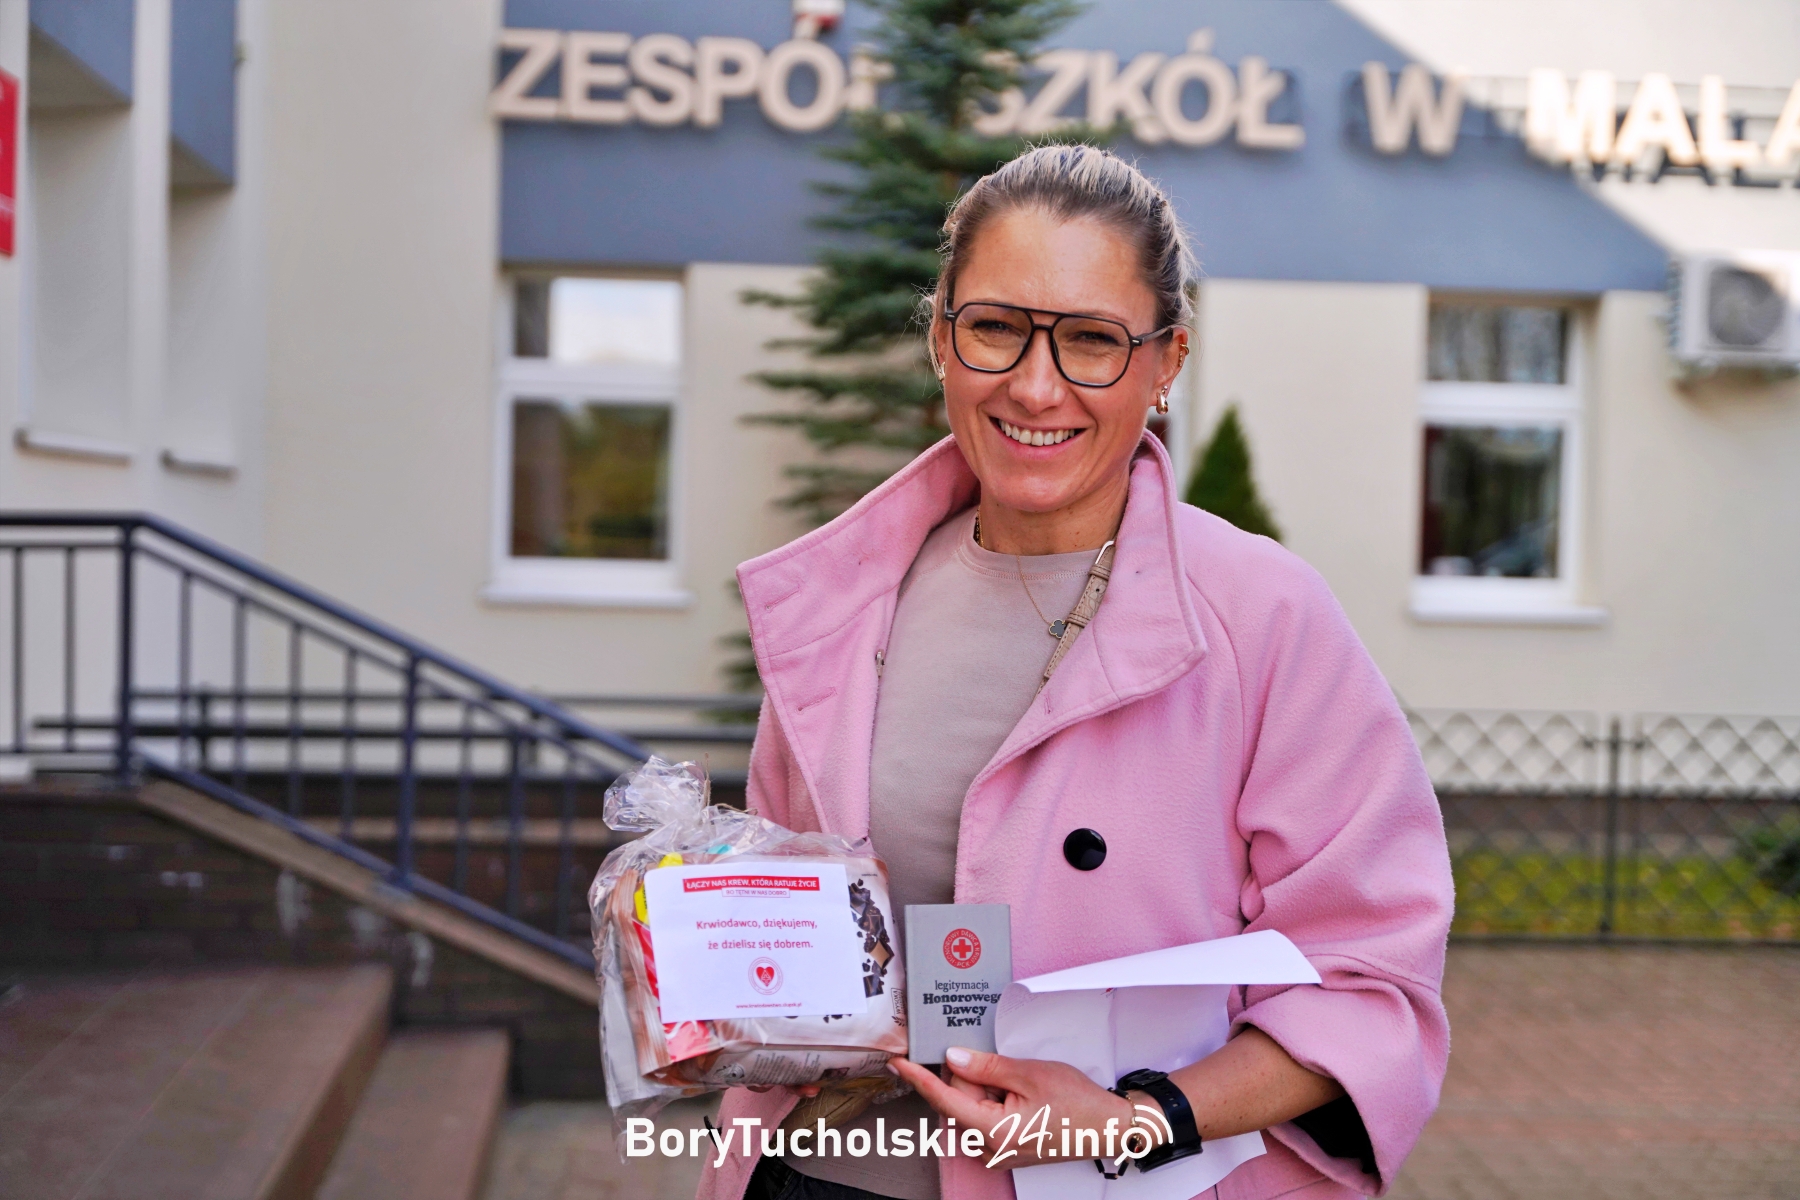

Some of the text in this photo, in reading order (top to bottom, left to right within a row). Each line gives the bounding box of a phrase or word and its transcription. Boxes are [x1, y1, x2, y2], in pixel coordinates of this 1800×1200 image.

[1361, 61, 1471, 157] W
[686, 880, 710, 890] ŁĄCZY
[711, 879, 727, 887] NAS
[751, 877, 774, 887] KTÓRA
[774, 879, 797, 888] RATUJE
[798, 878, 817, 888] ŻYCIE
[696, 918, 818, 930] Krwiodawco, dziękujemy,
[708, 939, 814, 950] że dzielisz się dobrem.
[934, 979, 989, 992] legitymacja
[942, 1005, 987, 1016] Dawcy
[947, 1016, 982, 1027] Krwi
